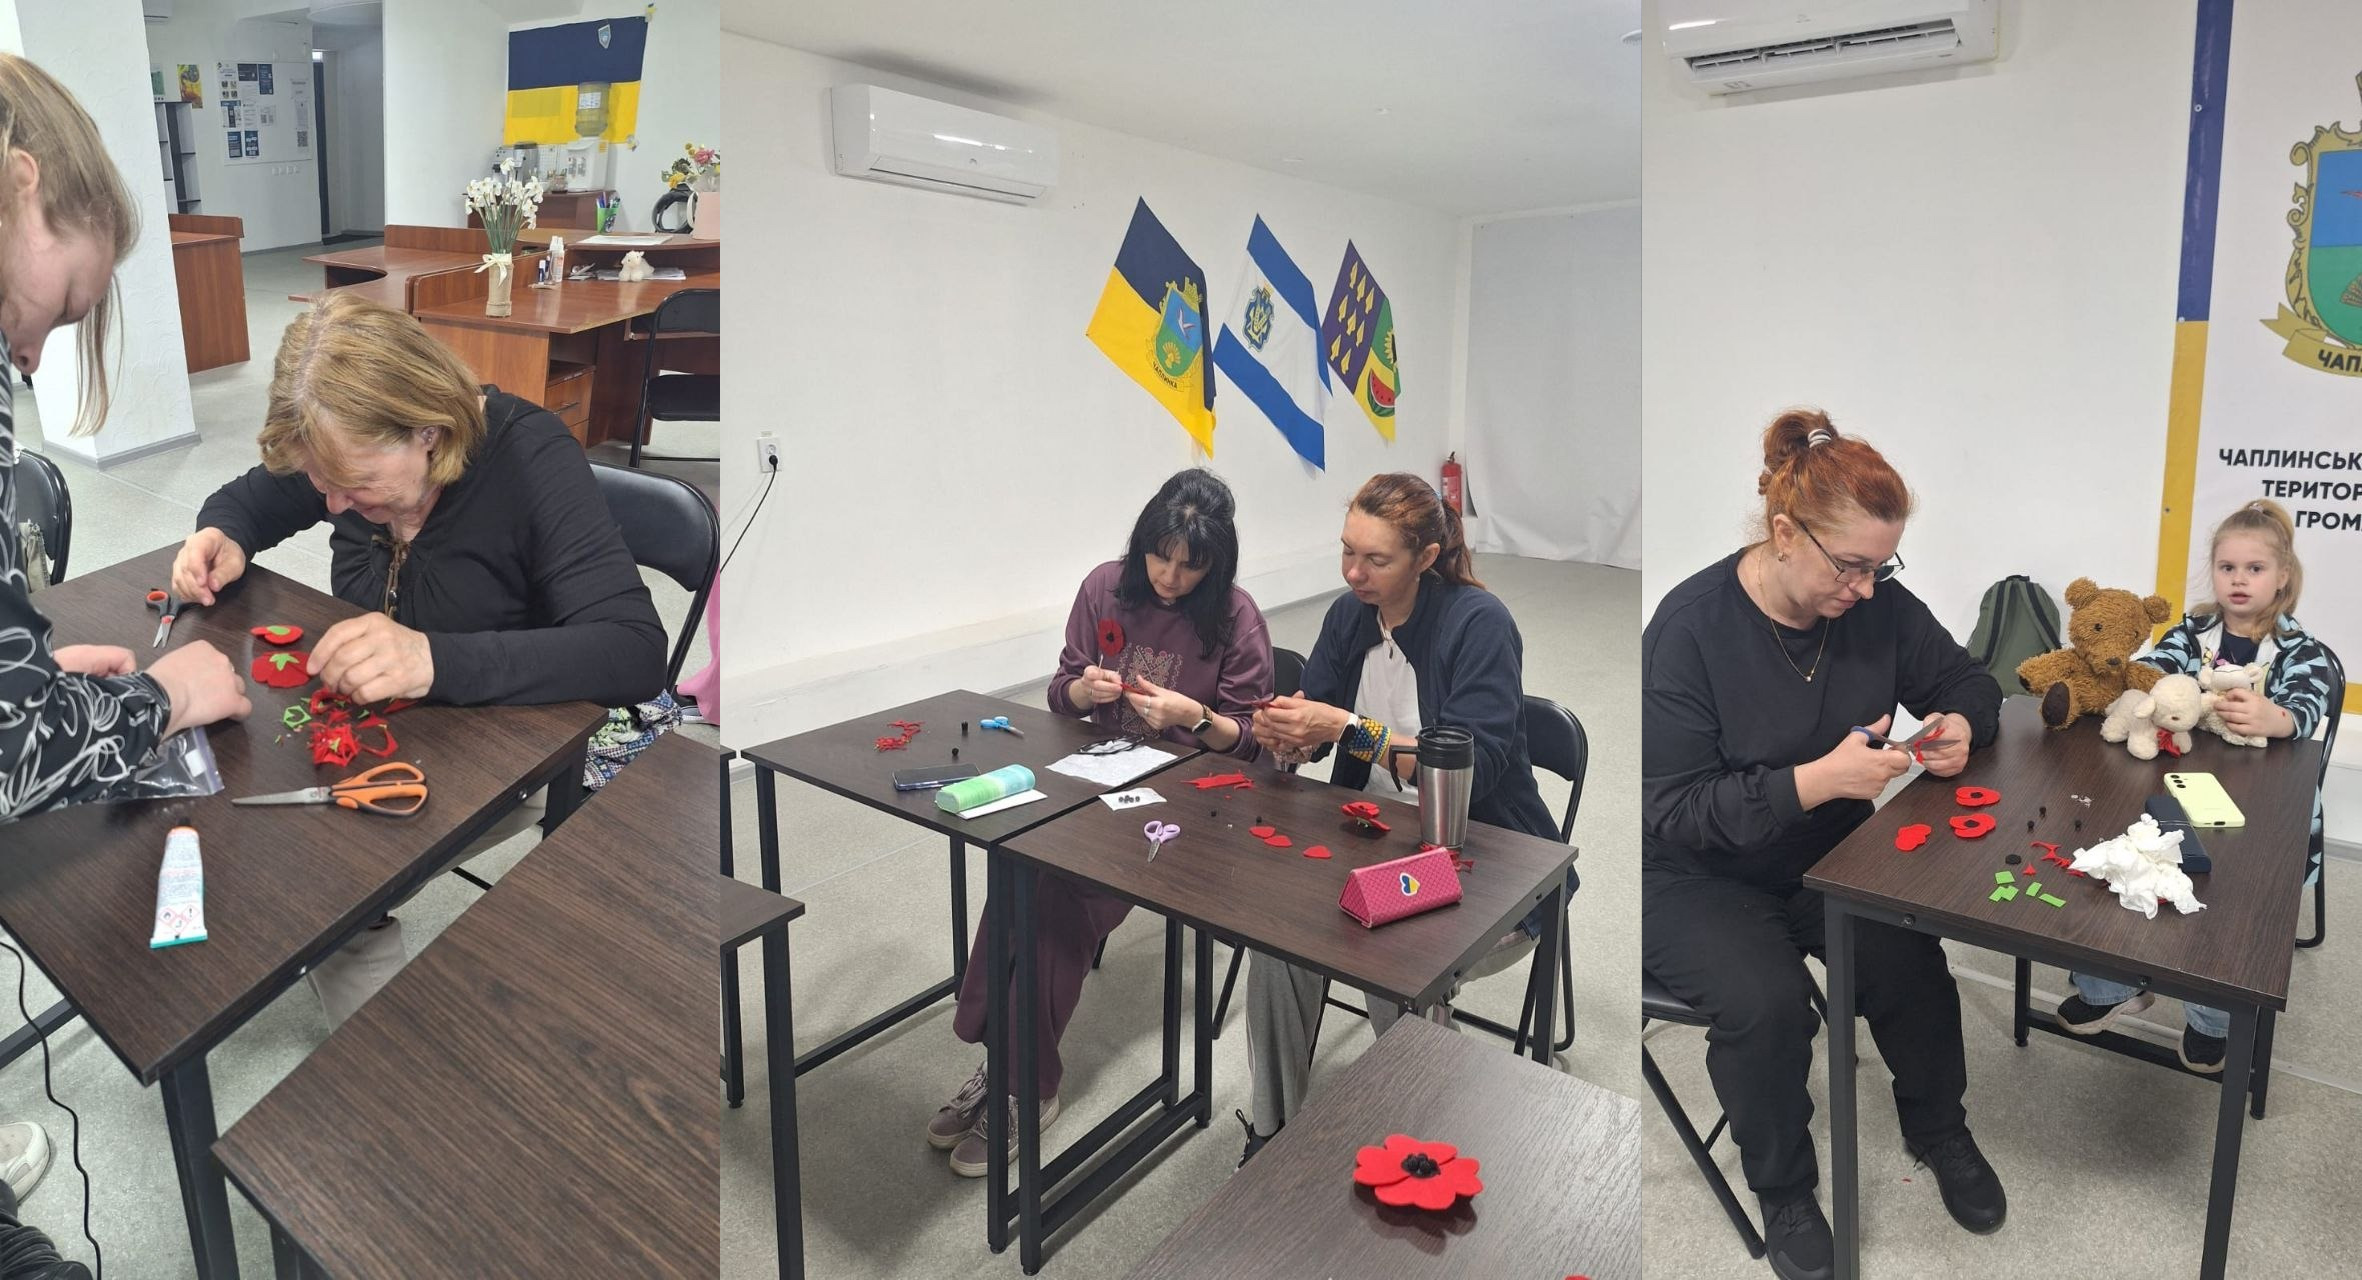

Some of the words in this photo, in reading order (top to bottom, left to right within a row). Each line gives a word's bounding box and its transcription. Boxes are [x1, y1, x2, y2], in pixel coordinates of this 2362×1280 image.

[2318, 349, 2362, 373] ЧАП
[2219, 448, 2362, 470] ЧАПЛИНСЬК
[2295, 510, 2362, 531] ГРОМ
